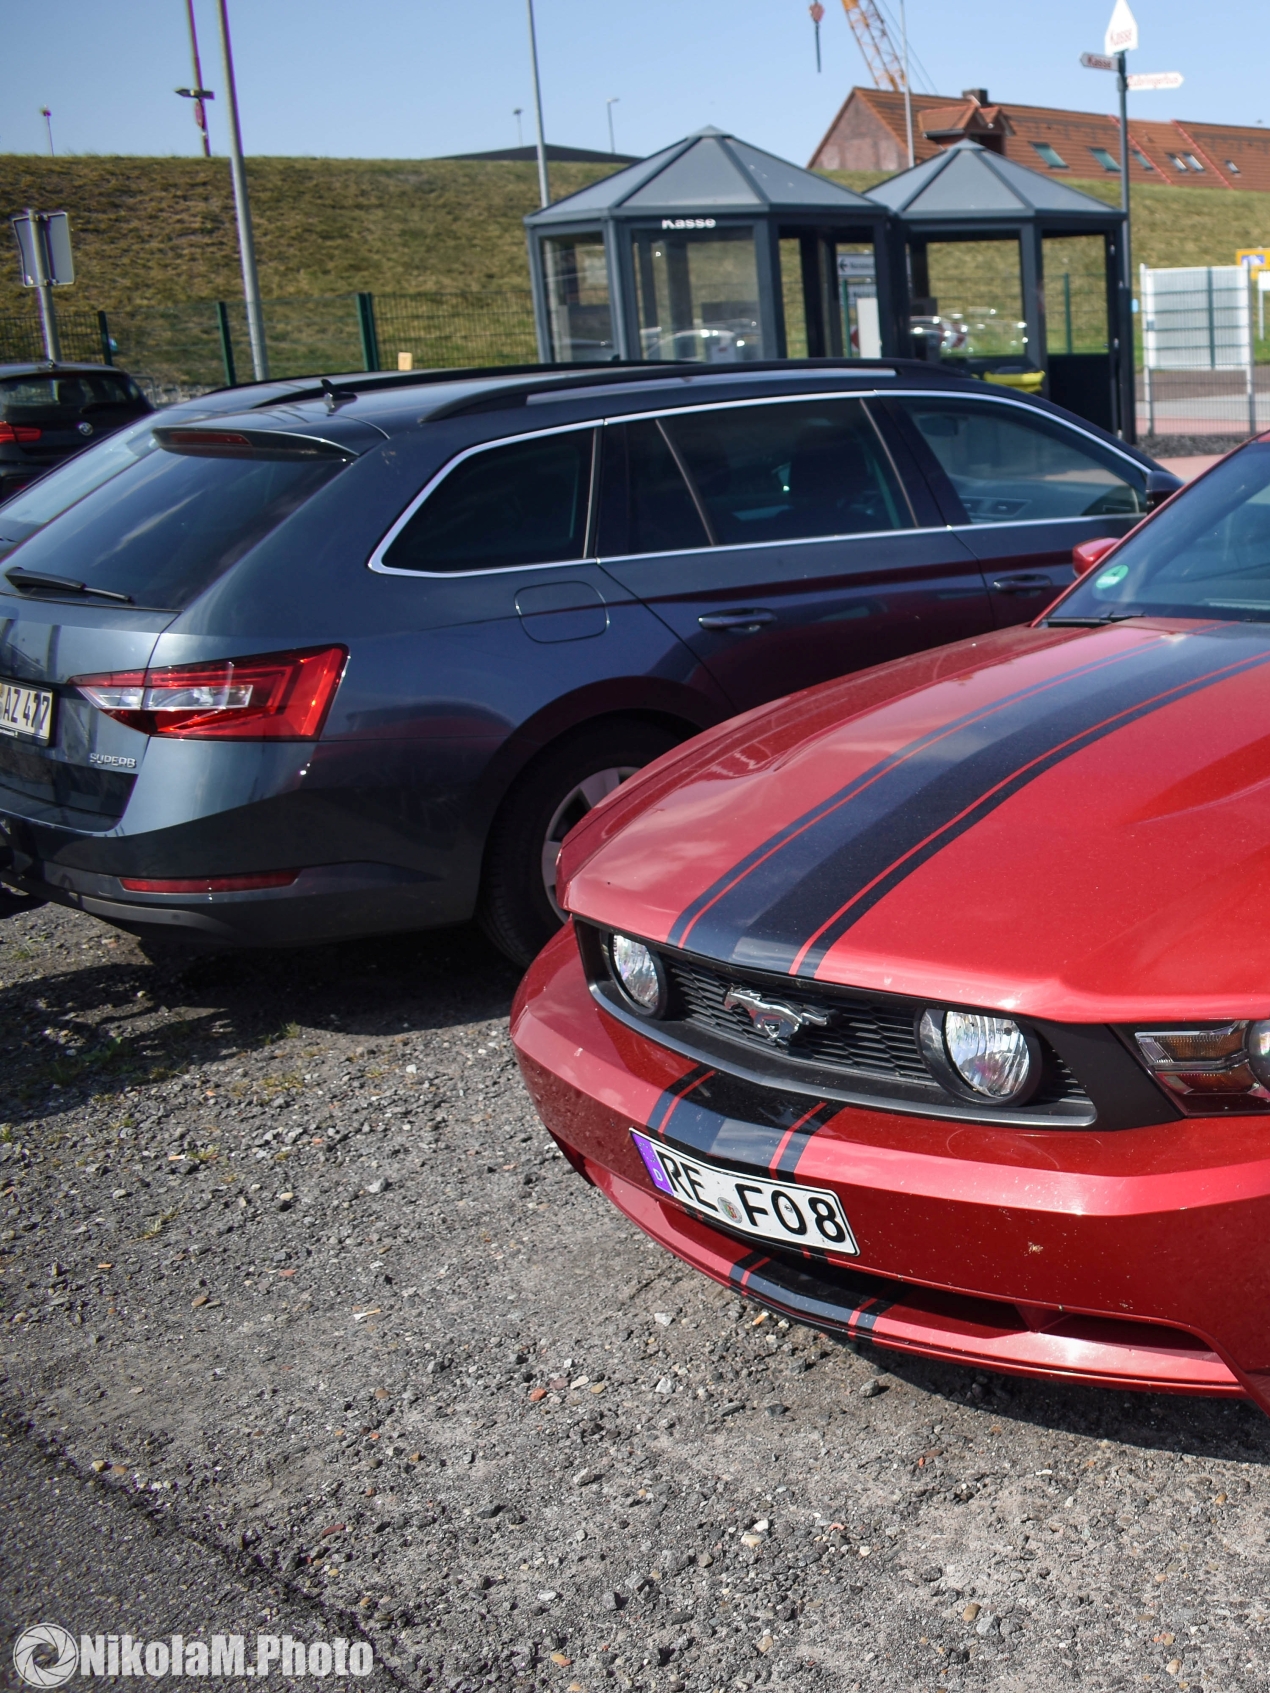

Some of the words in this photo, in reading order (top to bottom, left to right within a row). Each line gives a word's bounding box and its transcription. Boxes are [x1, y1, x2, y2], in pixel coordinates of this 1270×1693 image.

[1086, 55, 1112, 69] Kasse
[661, 218, 716, 230] Kasse
[2, 686, 22, 724] AZ
[23, 691, 51, 731] 477
[89, 752, 137, 769] SUPERB
[653, 1168, 663, 1183] D
[655, 1149, 719, 1213] RE
